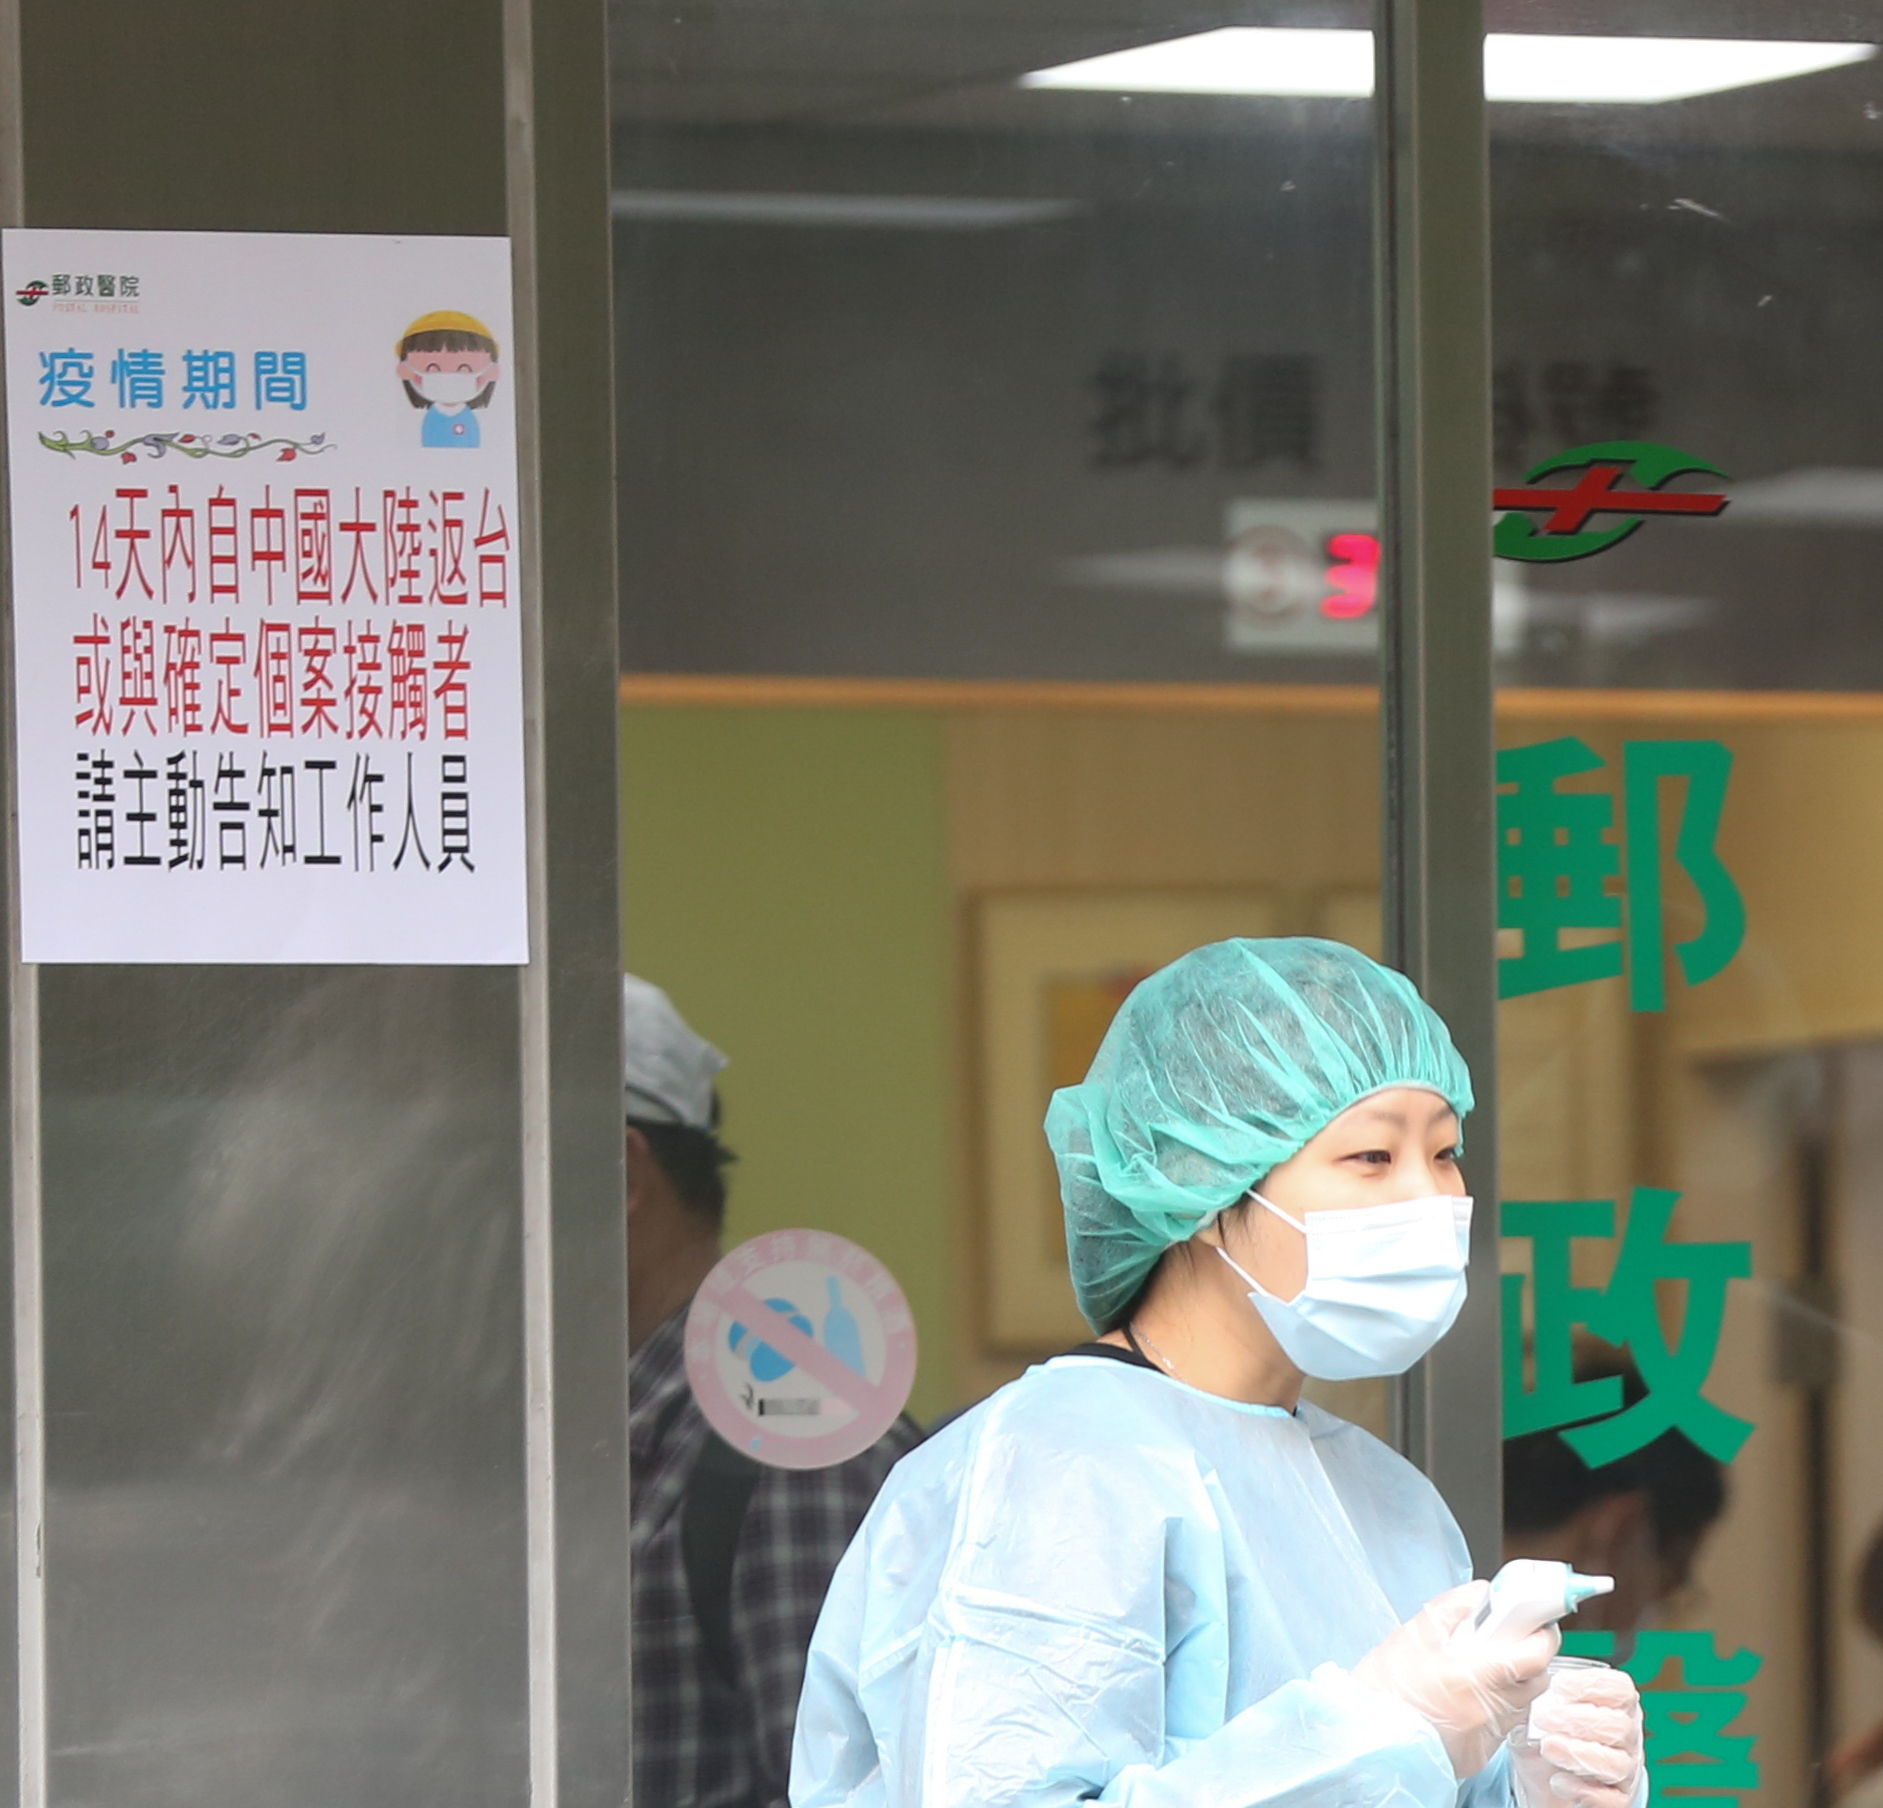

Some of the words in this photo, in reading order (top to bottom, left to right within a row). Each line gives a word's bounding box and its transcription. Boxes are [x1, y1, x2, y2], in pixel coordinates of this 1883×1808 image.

[51, 273, 140, 298] 郵政醫院
[38, 347, 309, 411] 疫情期間
[69, 484, 511, 608] 14天內自中國大陸返台
[73, 613, 472, 741] 或與確定個案接觸者
[75, 748, 476, 874] 請主動告知工作人員
